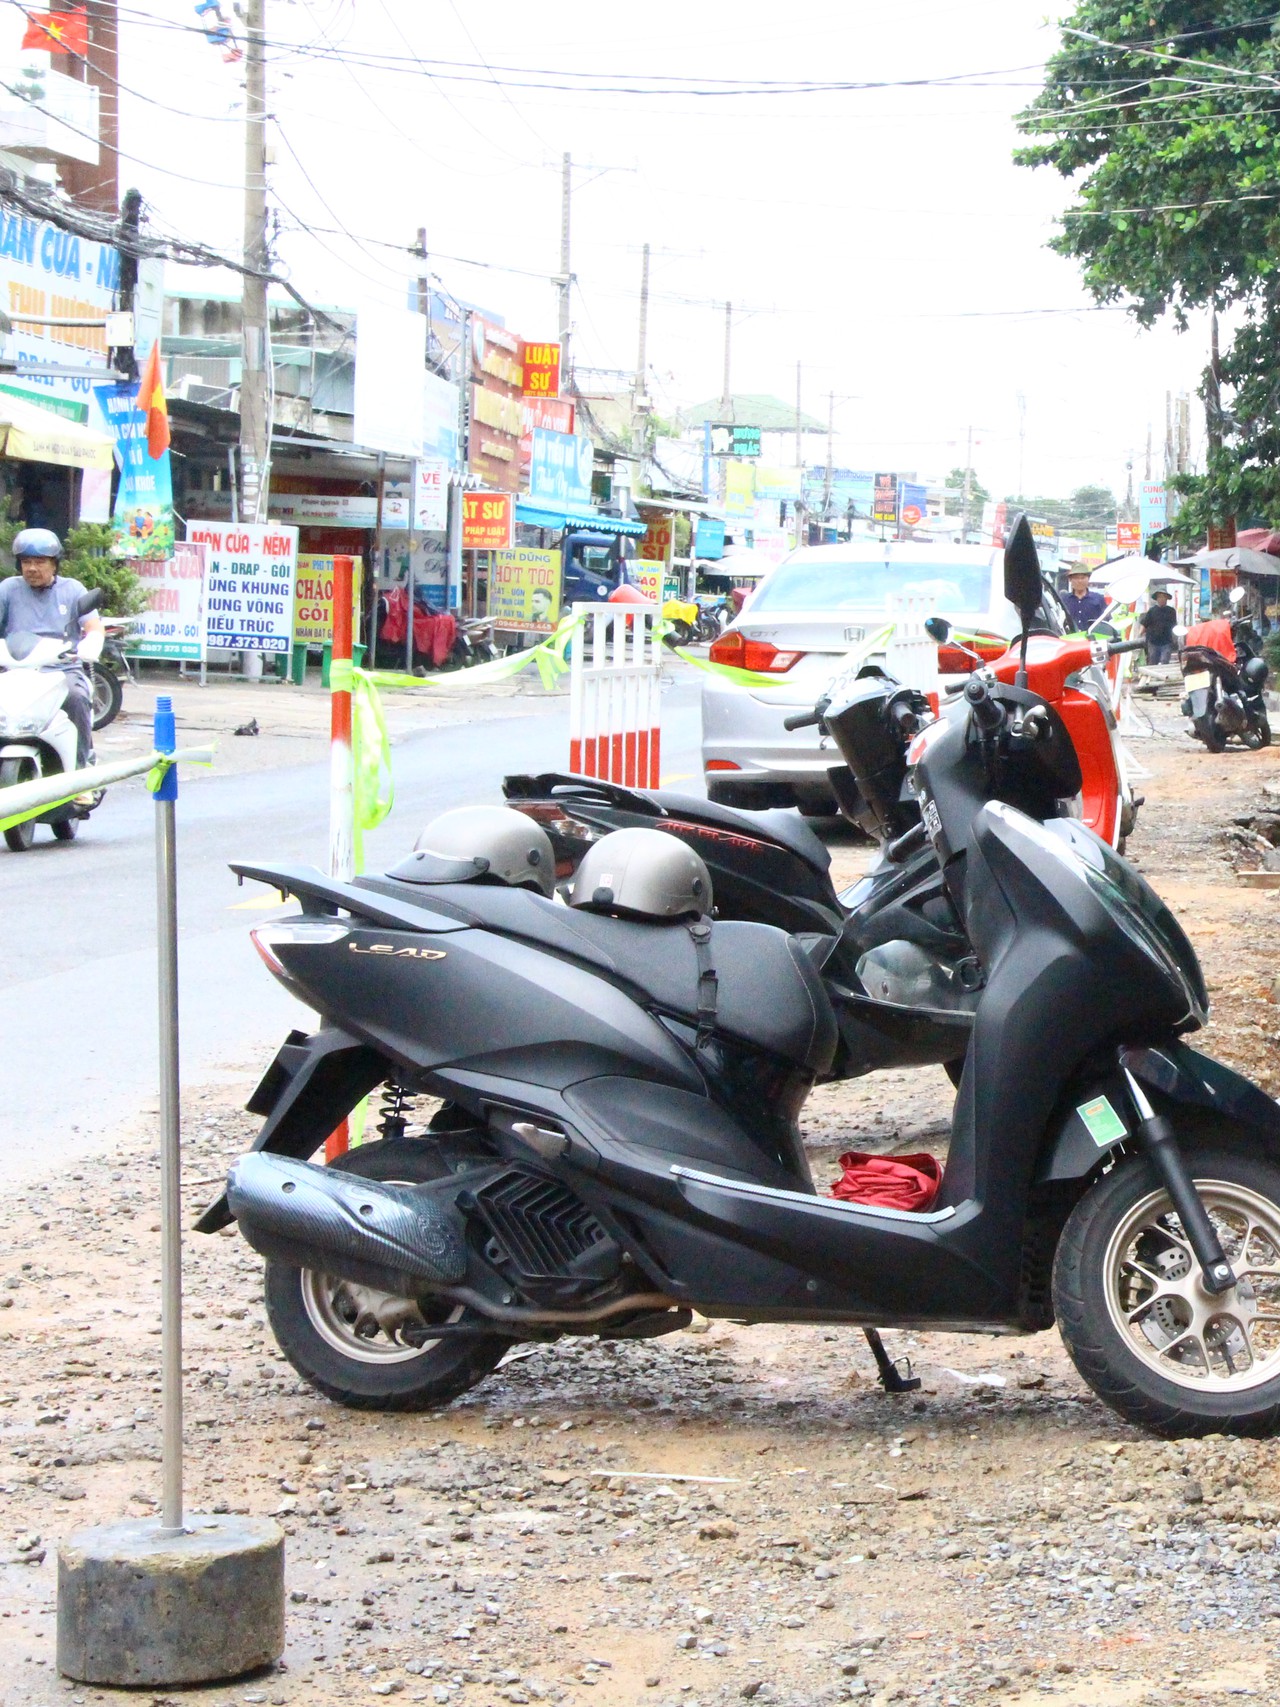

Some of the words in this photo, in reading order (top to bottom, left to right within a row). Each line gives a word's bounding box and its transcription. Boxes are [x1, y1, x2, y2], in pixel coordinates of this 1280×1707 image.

[525, 343, 560, 369] LUẬT
[530, 371, 551, 391] SƯ
[482, 499, 505, 520] SƯ
[263, 532, 291, 560] NỆM
[520, 550, 551, 563] DŨNG
[231, 563, 260, 575] DRAP
[528, 563, 554, 586] TÓC
[209, 576, 237, 592] ÙNG
[242, 581, 289, 596] KHUNG
[296, 574, 333, 600] CHÁO
[247, 597, 284, 614] VÕNG
[298, 603, 329, 621] GỎI
[154, 624, 175, 637] DRAP
[239, 617, 274, 633] TRÚC
[348, 942, 447, 960] LEAD
